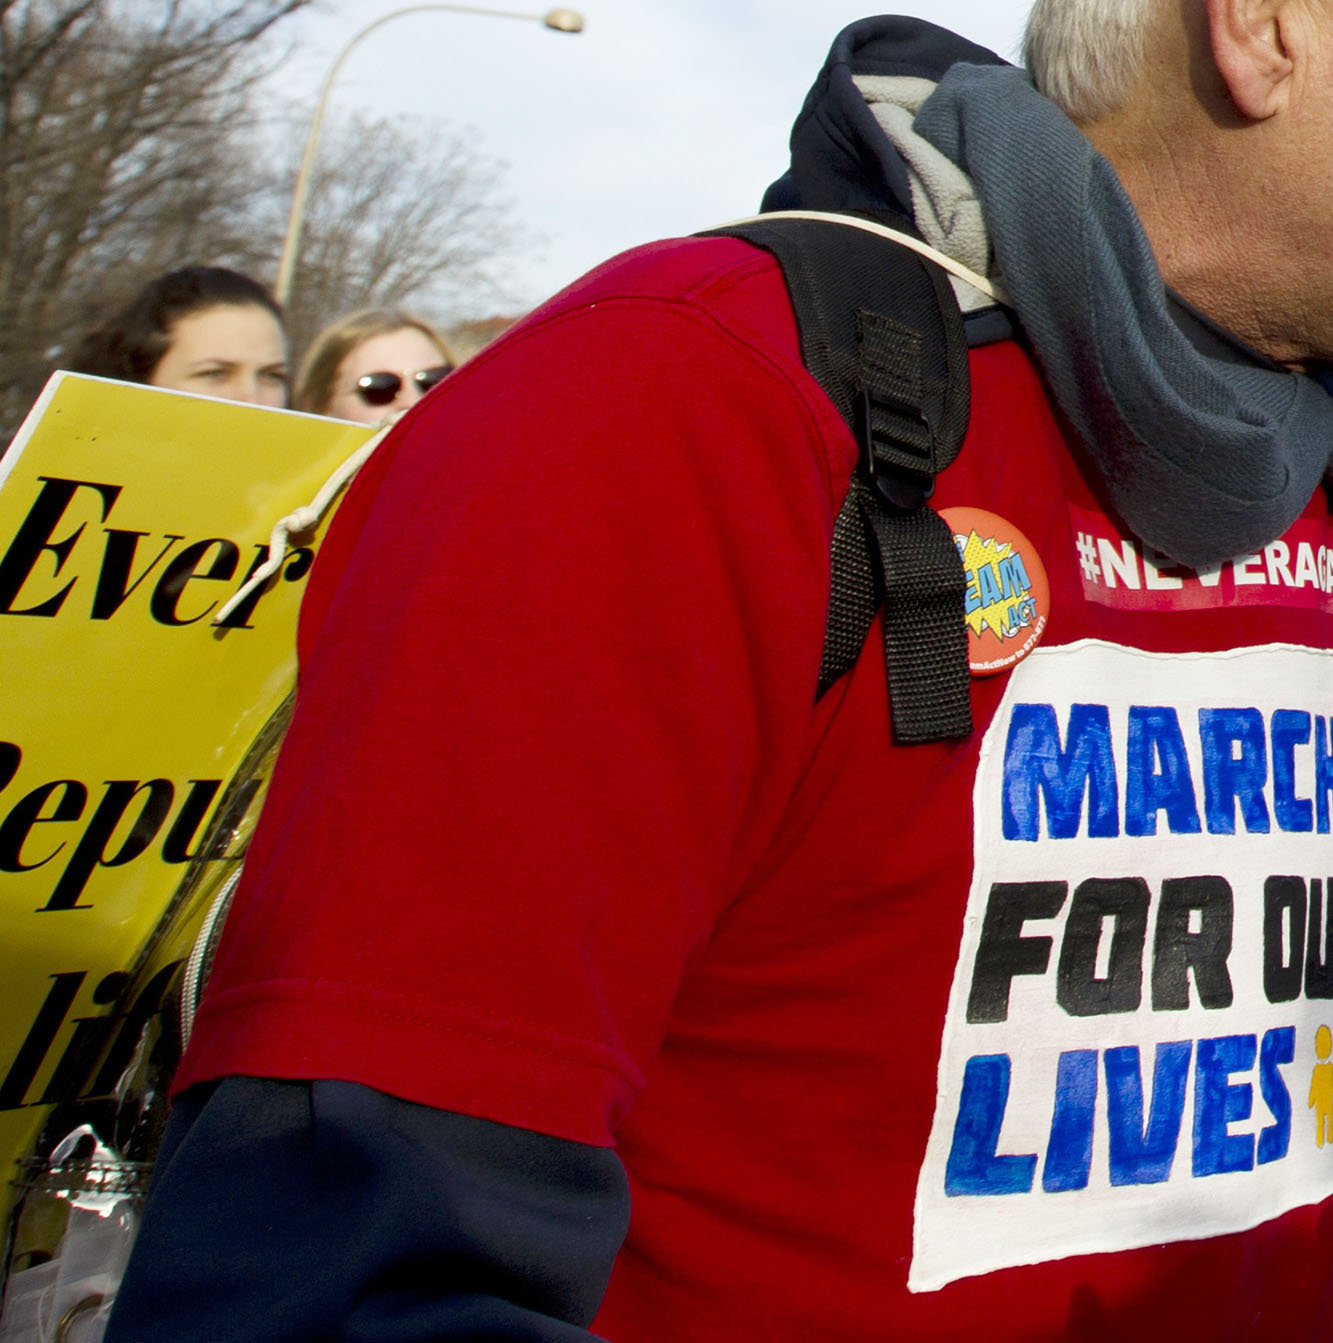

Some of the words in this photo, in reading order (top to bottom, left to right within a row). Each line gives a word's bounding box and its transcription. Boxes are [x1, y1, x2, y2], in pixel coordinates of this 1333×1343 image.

[0, 475, 313, 631] Ever
[965, 553, 1032, 614] EAM
[1008, 597, 1036, 628] ACT
[966, 875, 1233, 1023] FOR
[944, 1025, 1296, 1197] LIVES
